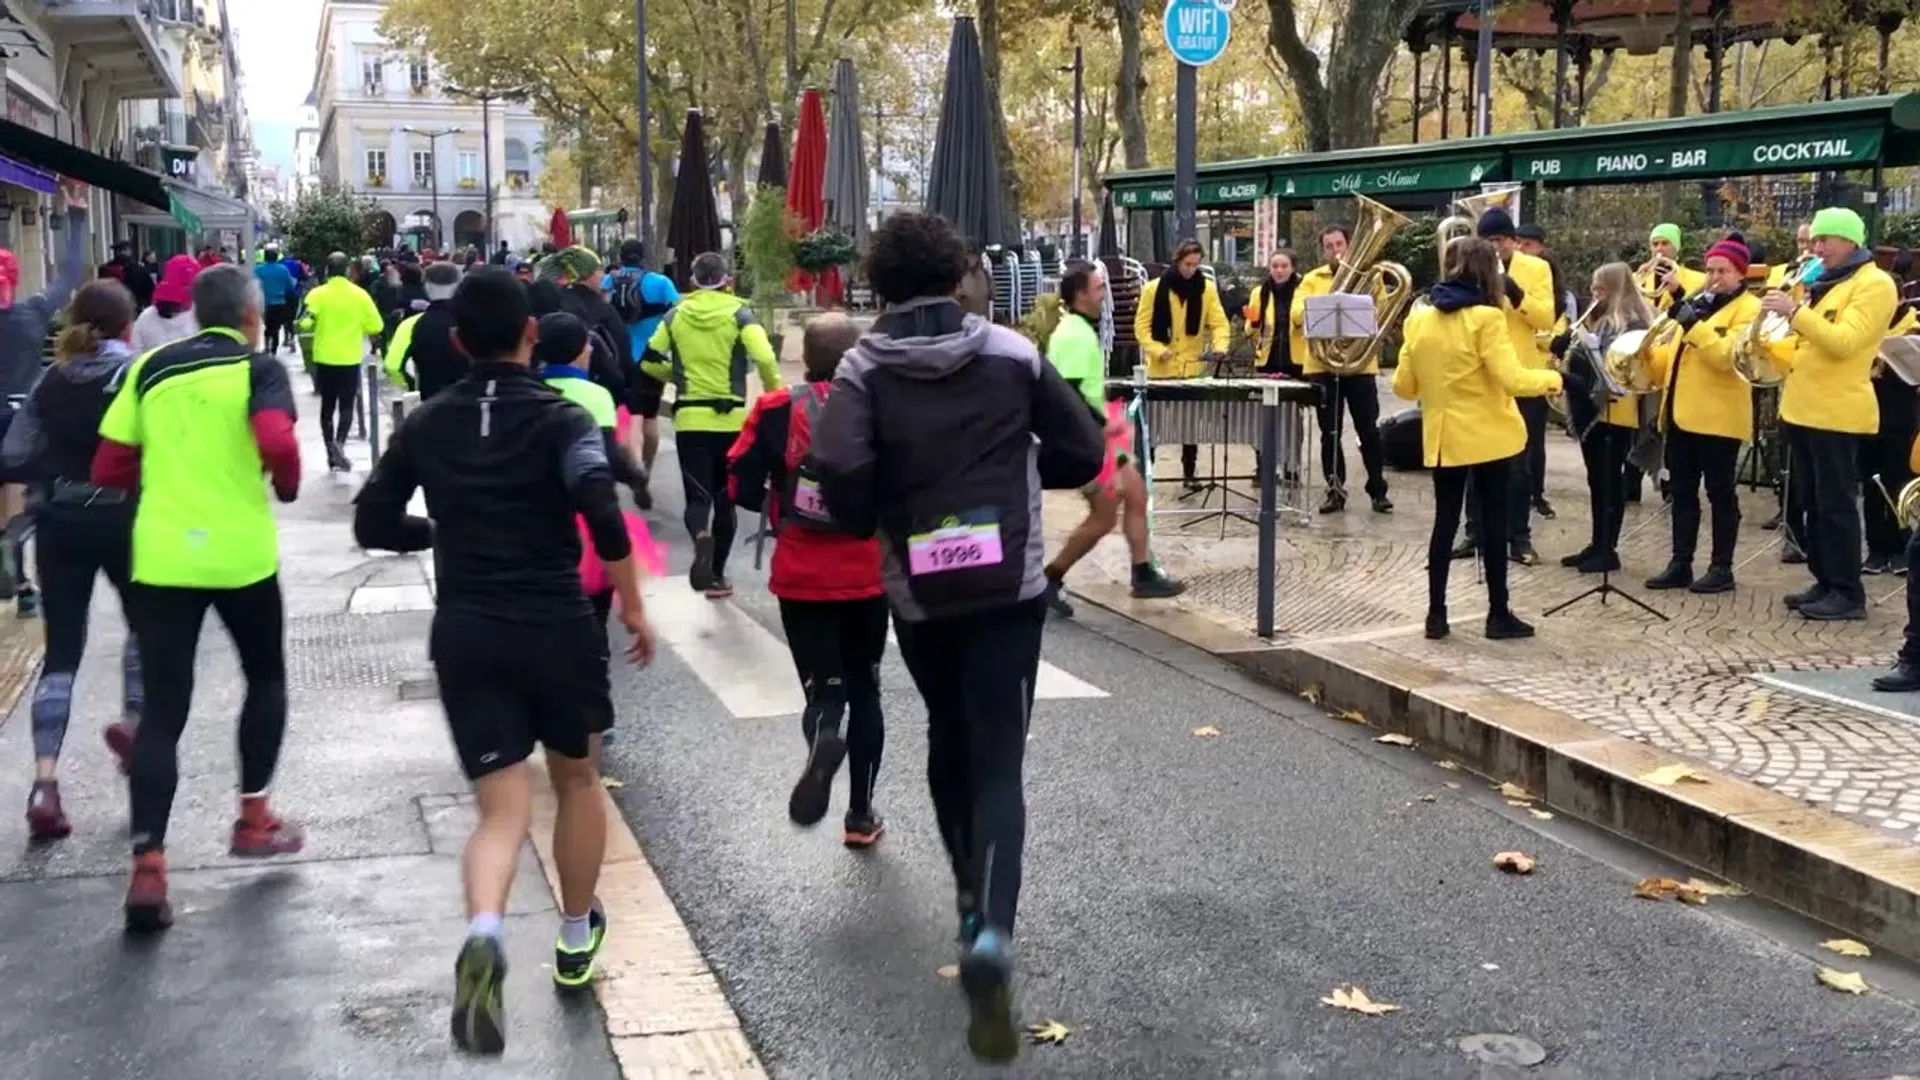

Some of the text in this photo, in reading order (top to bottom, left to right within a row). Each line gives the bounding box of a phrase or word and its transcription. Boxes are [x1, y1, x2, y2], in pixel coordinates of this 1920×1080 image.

[1178, 7, 1217, 34] WIFI
[1597, 154, 1647, 172] PIANO
[1671, 149, 1707, 168] BAR
[1753, 139, 1852, 163] COCKTAIL
[1531, 159, 1561, 175] PUB
[1218, 183, 1257, 198] GLACIER
[1332, 174, 1362, 192] Midi
[1376, 169, 1422, 189] Minuit
[929, 543, 983, 566] 1996
